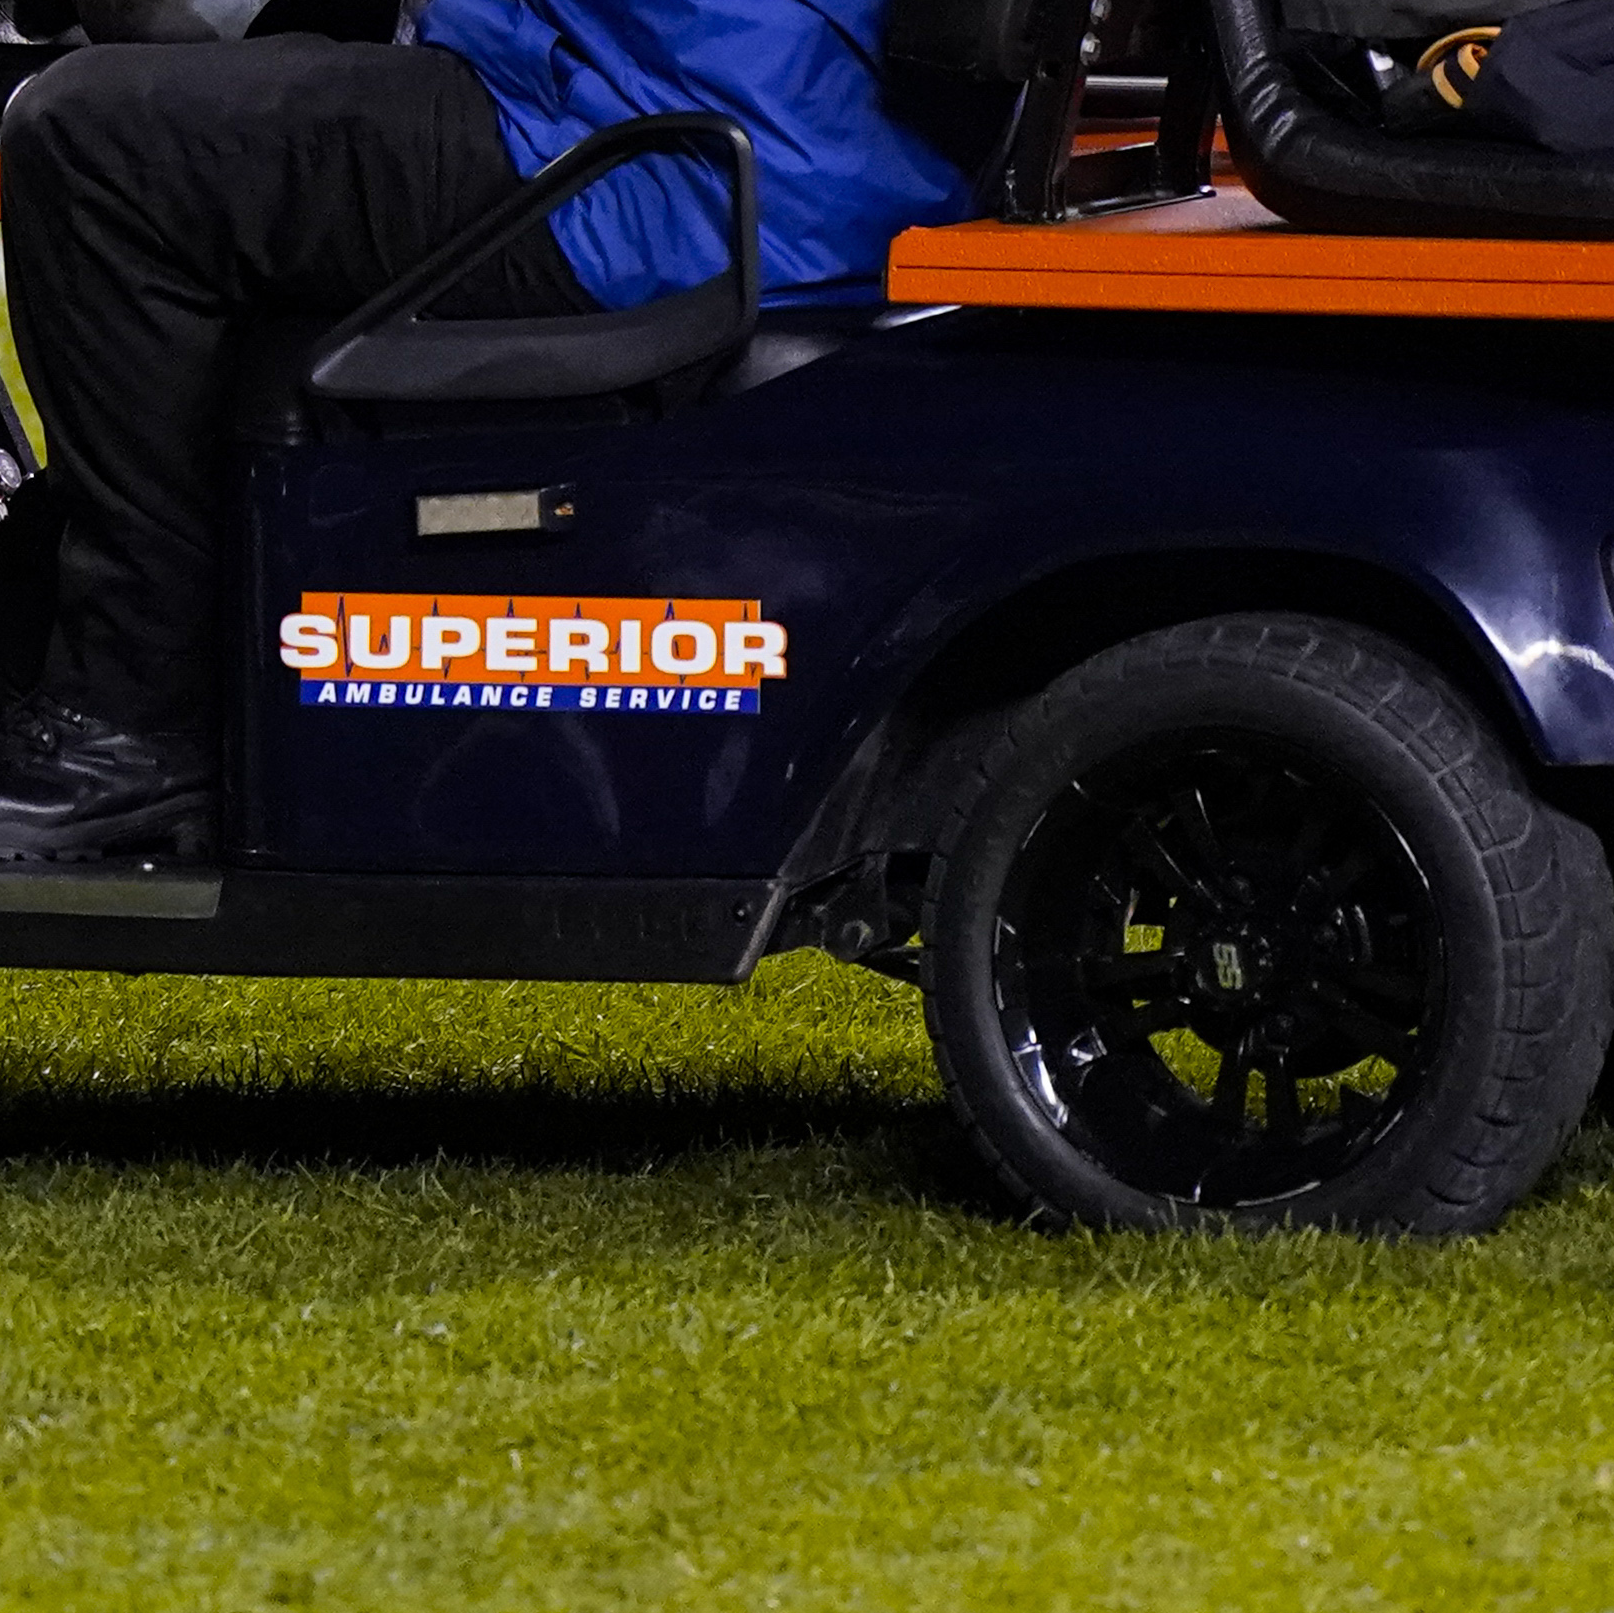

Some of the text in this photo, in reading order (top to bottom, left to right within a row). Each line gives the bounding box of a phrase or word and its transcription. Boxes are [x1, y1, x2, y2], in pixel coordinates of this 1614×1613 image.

[280, 613, 787, 678] SUPERIOR
[317, 681, 743, 712] AMBULANCE SERVICE
